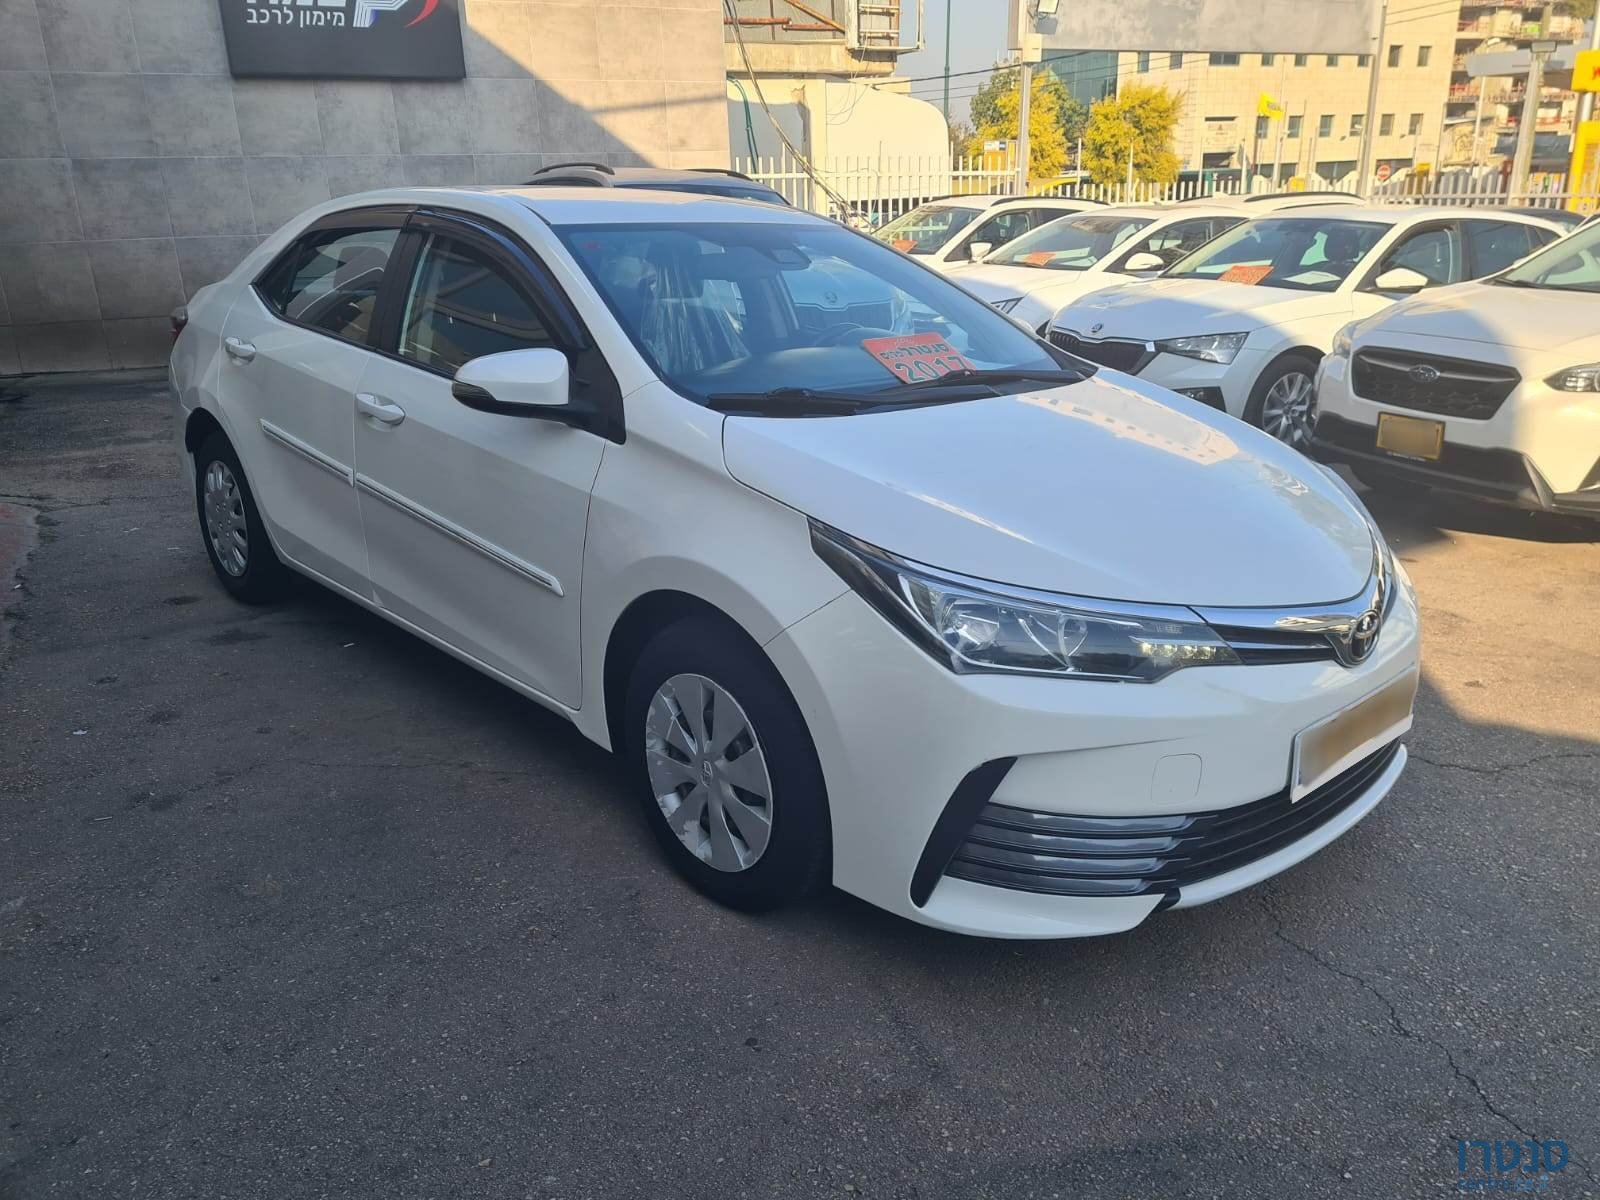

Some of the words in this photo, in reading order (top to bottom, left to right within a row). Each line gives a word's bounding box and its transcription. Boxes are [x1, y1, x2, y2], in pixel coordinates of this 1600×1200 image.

[246, 6, 293, 25] לרכב
[299, 10, 345, 28] מימון
[894, 355, 971, 382] 2017
